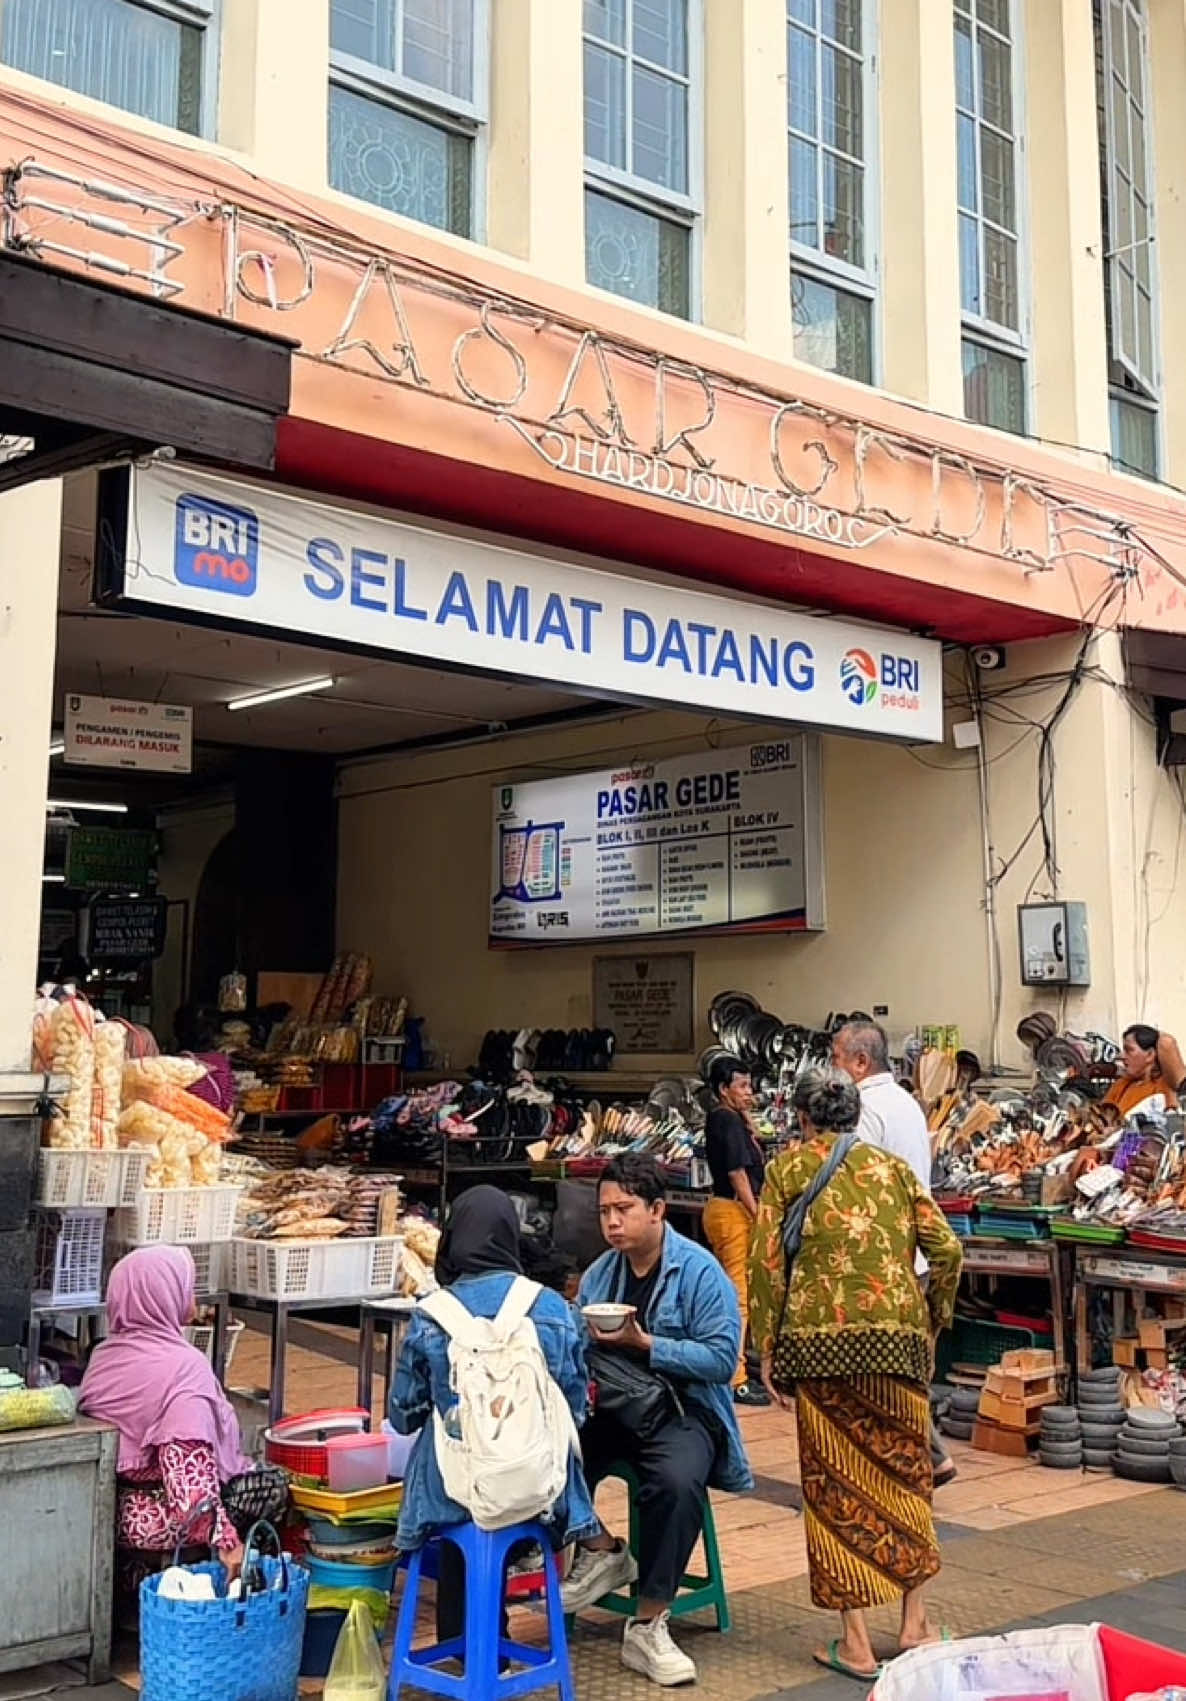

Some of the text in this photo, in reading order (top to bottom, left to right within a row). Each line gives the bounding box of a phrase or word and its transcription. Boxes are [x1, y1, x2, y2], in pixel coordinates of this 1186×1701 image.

[222, 202, 714, 469] PASAR
[574, 433, 843, 541] HARDJONAGORO
[184, 508, 249, 557] BRI
[193, 551, 251, 585] mo
[303, 536, 815, 692] SELAMAT DATANG
[880, 652, 919, 692] BRI
[880, 692, 919, 711] peduli
[75, 734, 181, 754] DILARANG MASUK
[767, 742, 791, 765] BRI
[597, 769, 740, 819] PASAR GEDE
[597, 831, 623, 845] BLOK
[701, 819, 710, 832] K
[734, 811, 780, 829] BLOK IV
